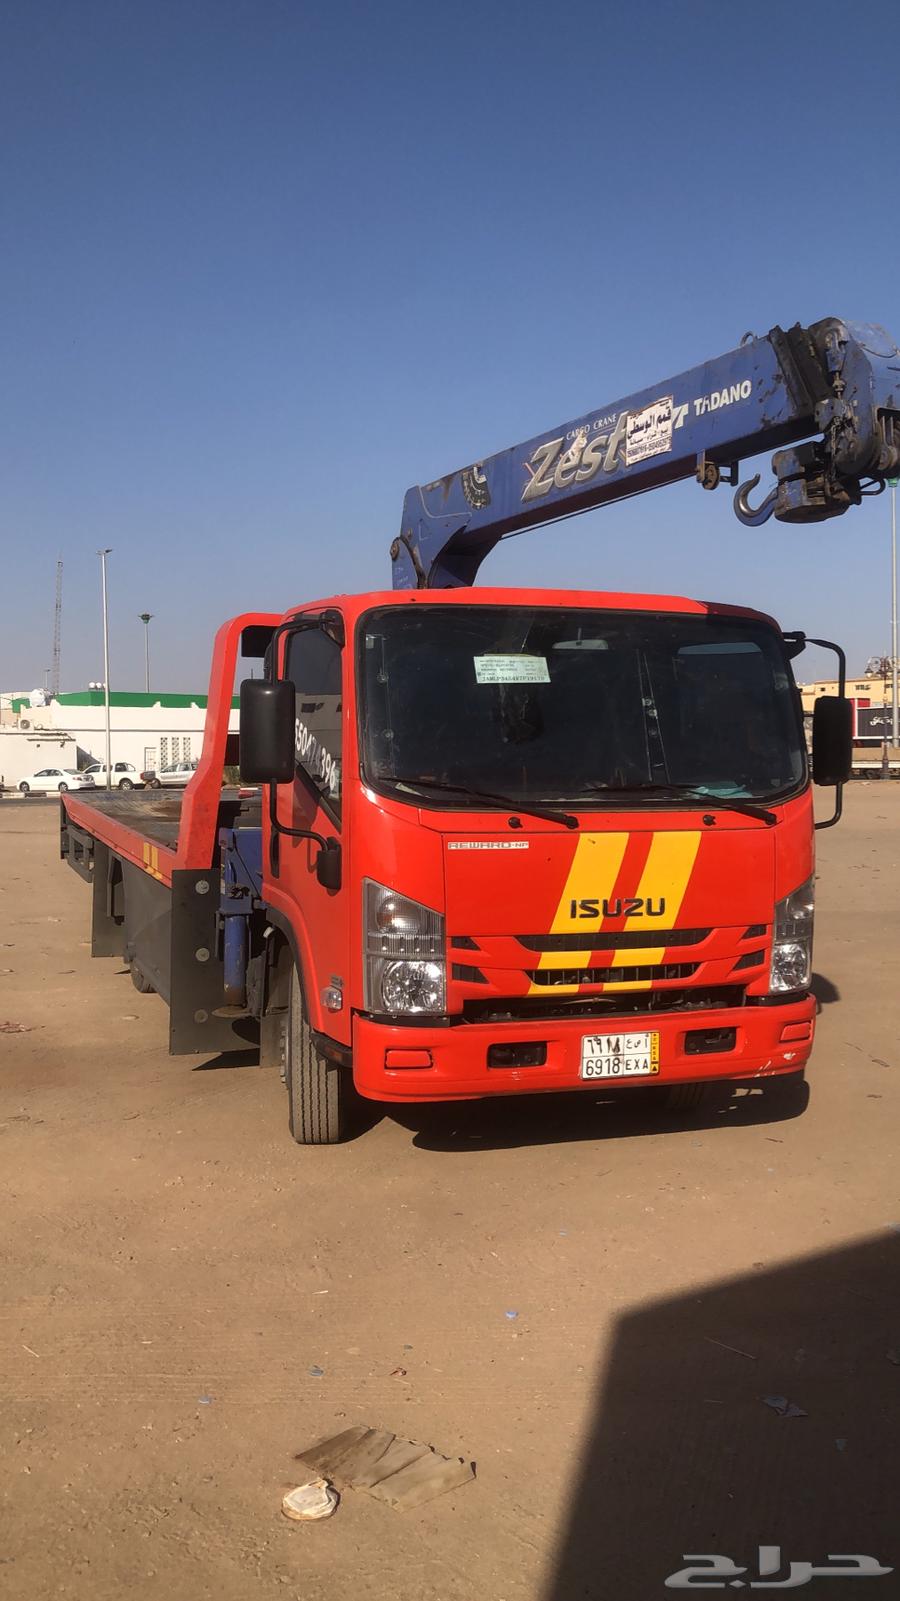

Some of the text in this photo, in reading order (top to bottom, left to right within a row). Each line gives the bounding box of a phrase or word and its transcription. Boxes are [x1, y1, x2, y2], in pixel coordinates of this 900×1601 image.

[693, 380, 752, 416] TADANO
[566, 424, 591, 441] CARGO
[593, 413, 617, 430] CRANE
[521, 410, 630, 502] Zest
[570, 898, 666, 919] ISUZU
[586, 1057, 620, 1076] 6918
